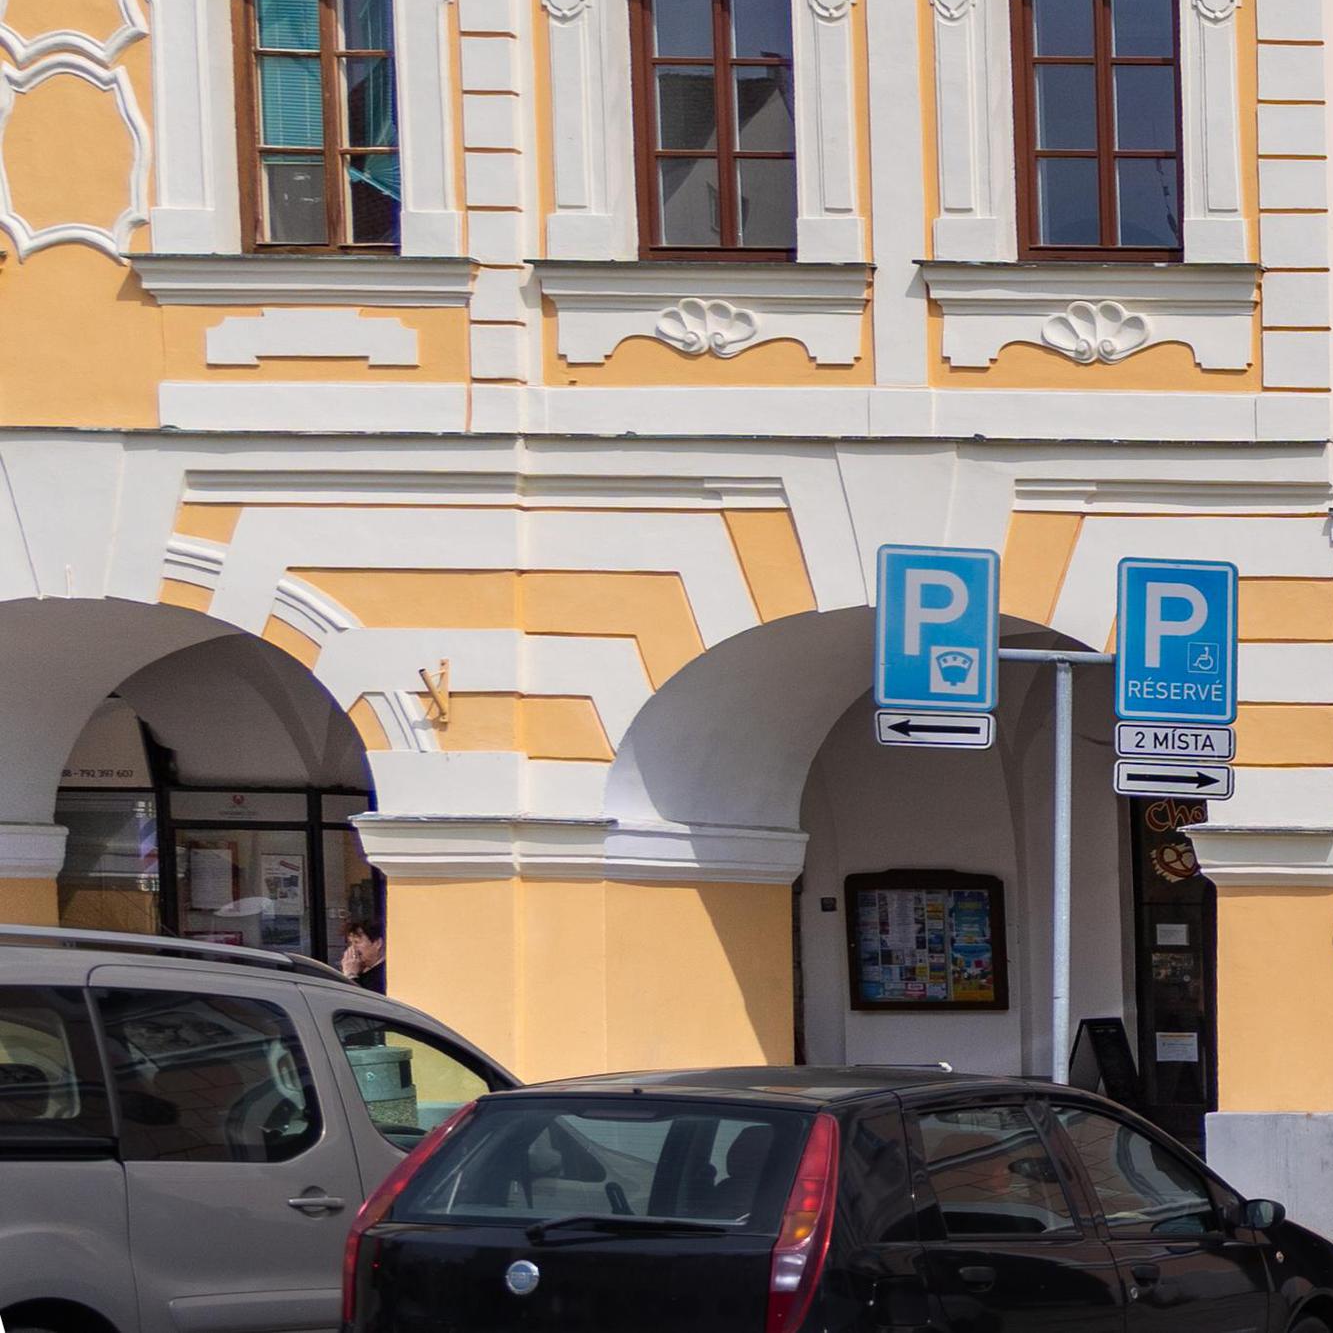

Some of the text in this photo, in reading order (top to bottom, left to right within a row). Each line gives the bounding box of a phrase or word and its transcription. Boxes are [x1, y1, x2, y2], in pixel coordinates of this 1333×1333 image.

[904, 568, 968, 655] P
[1144, 582, 1208, 668] P
[1127, 677, 1224, 702] RÉSERVÉ
[1134, 728, 1215, 751] 2 MÍSTA
